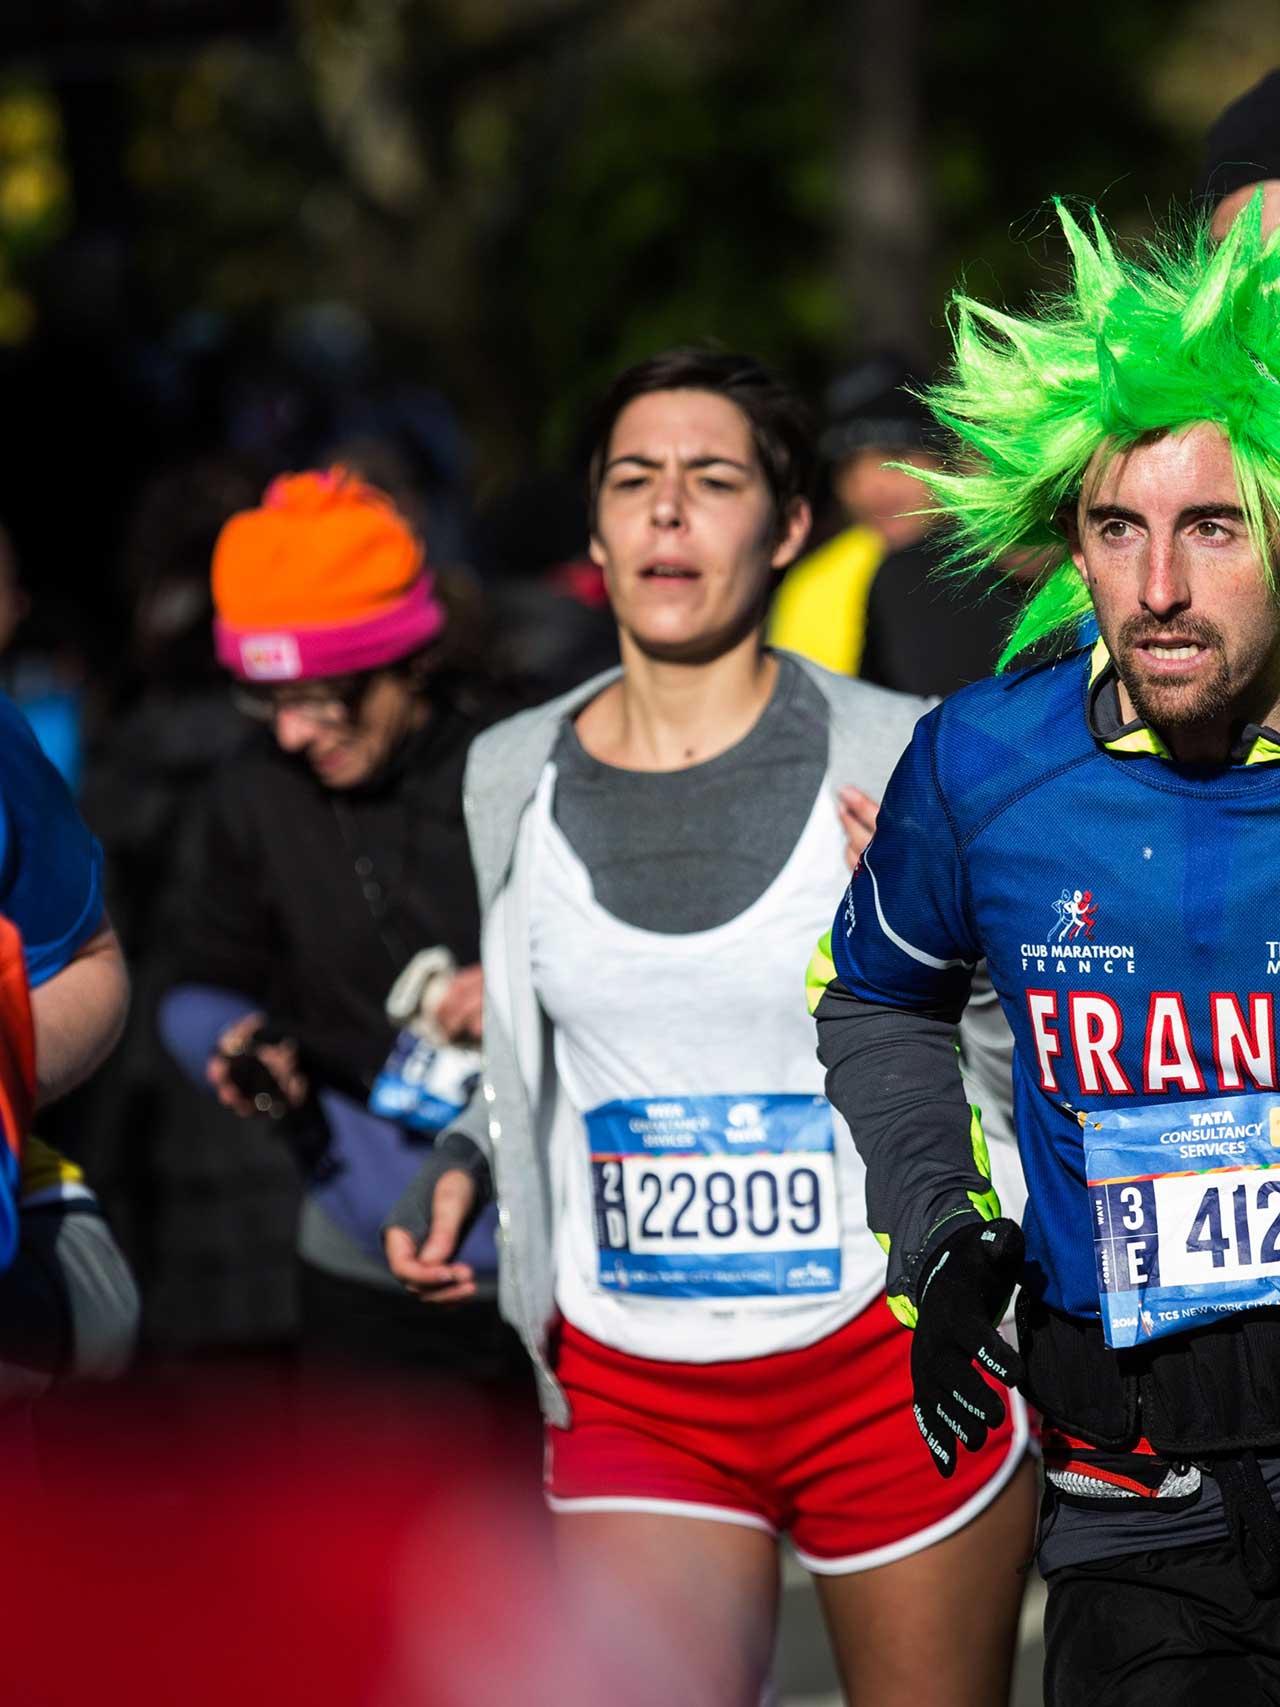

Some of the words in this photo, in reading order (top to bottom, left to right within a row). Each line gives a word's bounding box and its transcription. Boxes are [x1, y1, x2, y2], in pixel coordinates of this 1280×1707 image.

[1020, 943, 1048, 958] CLUB
[1050, 944, 1134, 959] MARATHON
[1022, 959, 1136, 974] FRANCE
[1189, 1110, 1235, 1127] TATA
[1160, 1122, 1263, 1145] CONSULTANCY
[1179, 1141, 1246, 1159] SERVICES
[602, 1161, 621, 1203] 2
[640, 1167, 821, 1238] 22809
[1095, 1199, 1105, 1226] WAVE
[1119, 1186, 1146, 1231] 3
[1126, 1241, 1149, 1286] E
[1112, 1317, 1139, 1329] 2014
[1158, 1310, 1180, 1322] TCS
[1181, 1305, 1208, 1318] NEW
[1210, 1303, 1243, 1313] YORK
[977, 1346, 1008, 1377] bronx
[952, 1389, 987, 1421] queens
[936, 1403, 969, 1444] brooklyn
